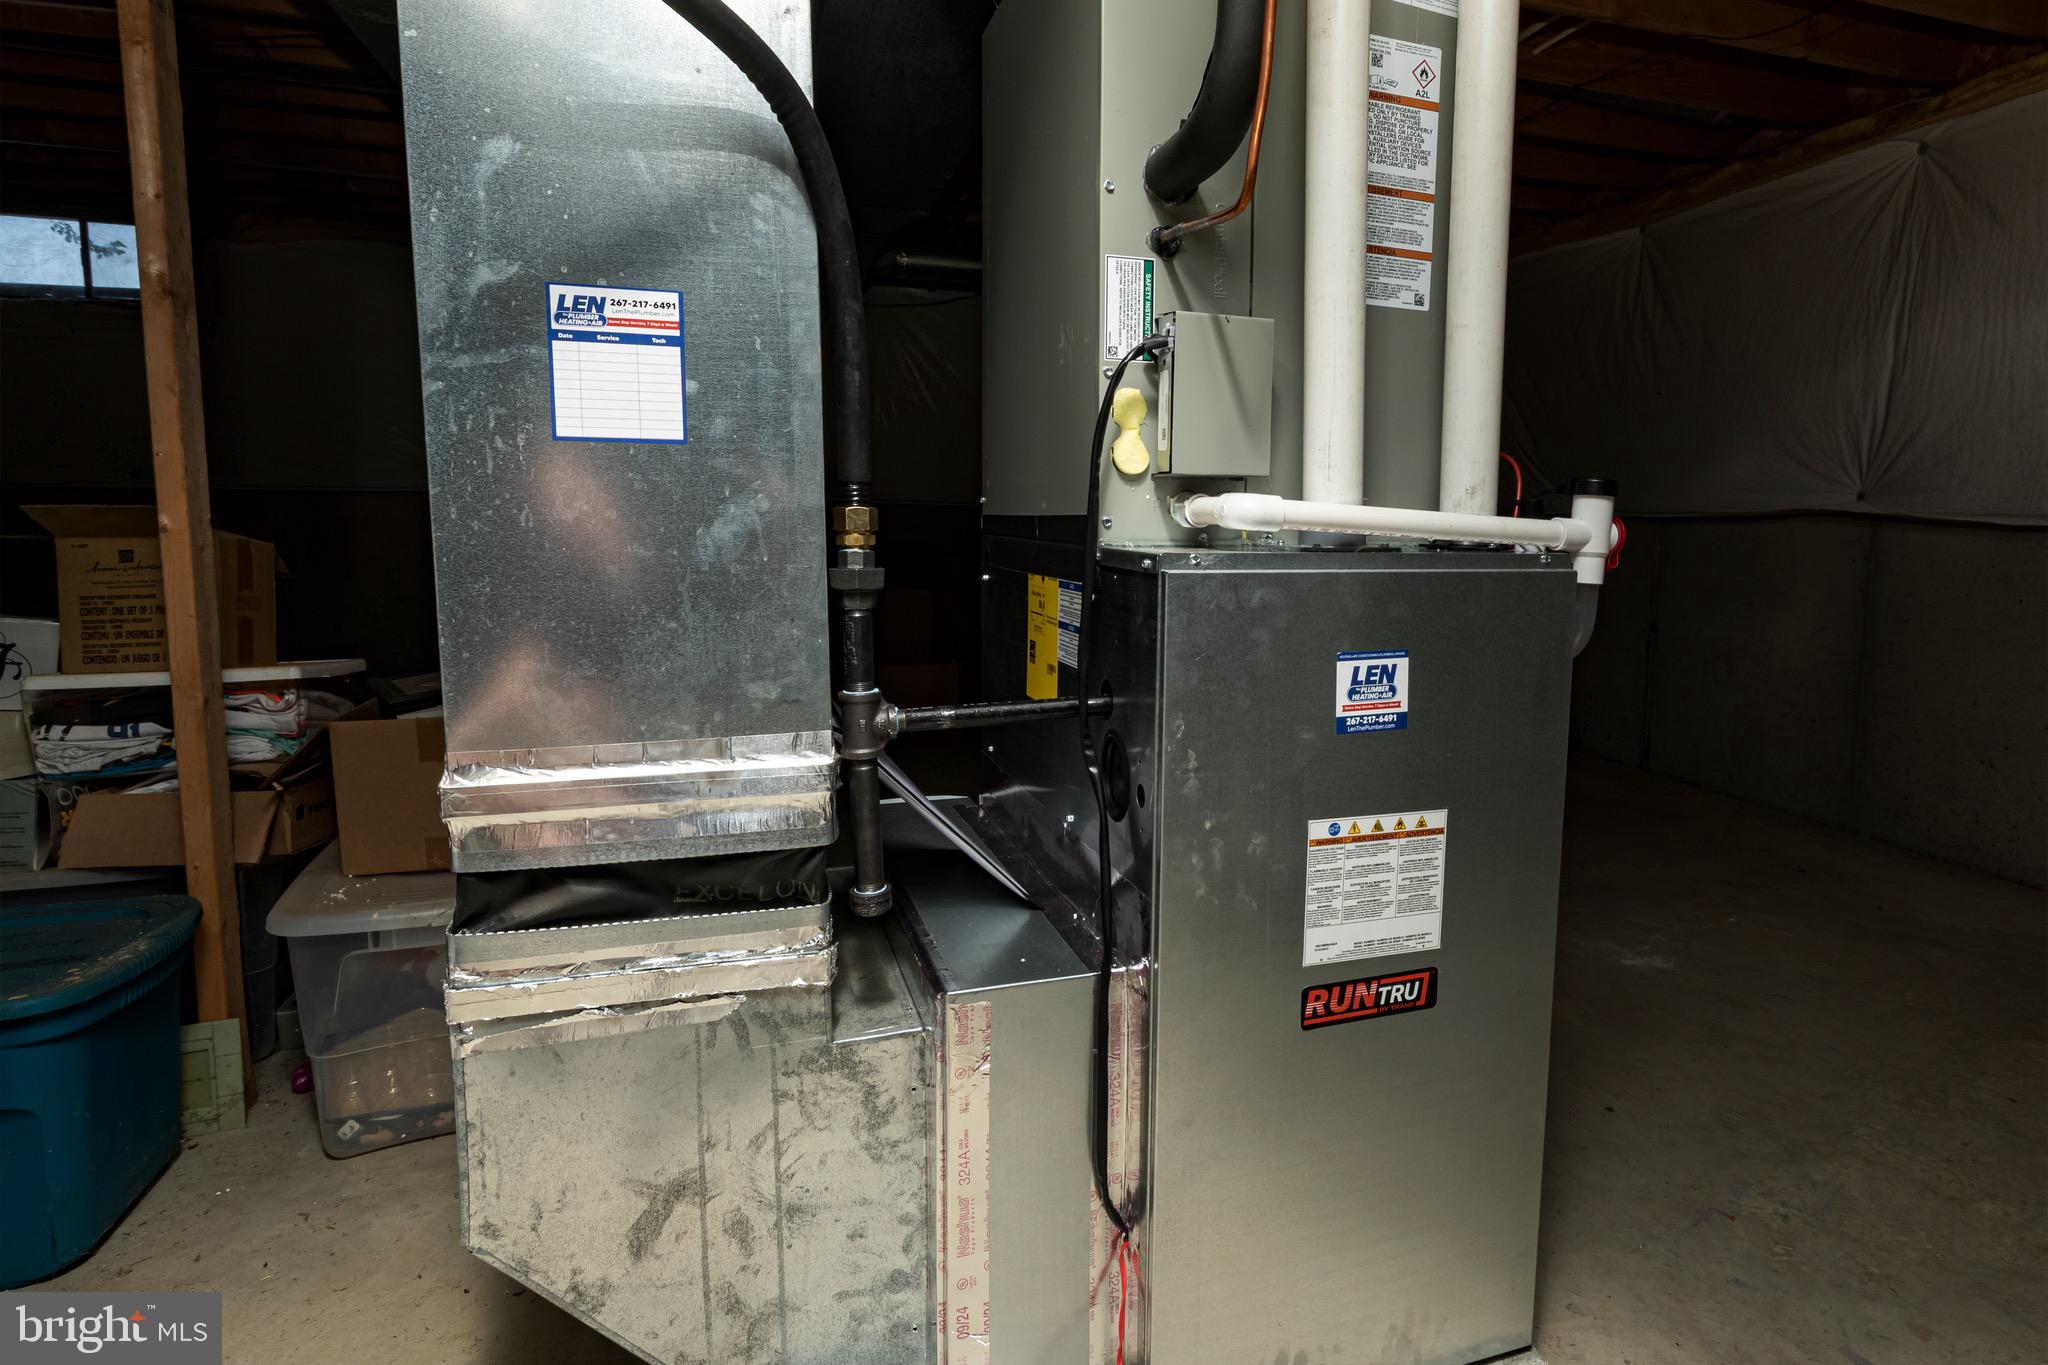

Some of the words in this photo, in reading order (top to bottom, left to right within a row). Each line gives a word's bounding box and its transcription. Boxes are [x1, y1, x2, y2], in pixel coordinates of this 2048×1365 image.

[1416, 89, 1430, 99] A2L
[556, 293, 606, 314] LEN
[610, 298, 676, 310] 267-217-6491
[612, 308, 675, 318] LenThePlumber.com
[80, 607, 107, 616] CONTENT
[113, 607, 124, 615] ONE
[127, 606, 136, 615] SET
[139, 606, 146, 614] OF
[81, 632, 110, 641] CONTENU
[114, 631, 123, 640] UN
[125, 630, 153, 639] ENSEMBLE
[157, 630, 164, 638] DE
[82, 655, 116, 664] CONTENIDO
[121, 655, 129, 663] UN
[132, 654, 150, 663] JUEGO
[153, 653, 160, 662] DE
[1350, 663, 1397, 686] LEN
[1346, 714, 1396, 726] 267-217-6491
[1348, 724, 1395, 732] LenThePlumber.com
[1406, 828, 1444, 838] ADVERTENCIA
[1316, 838, 1343, 846] WARNING
[1391, 1002, 1415, 1011] TRANE
[1110, 1072, 1121, 1107] 324A
[958, 1150, 970, 1186] 324A
[1109, 1271, 1120, 1305] 324A
[956, 1306, 969, 1340] 09/24
